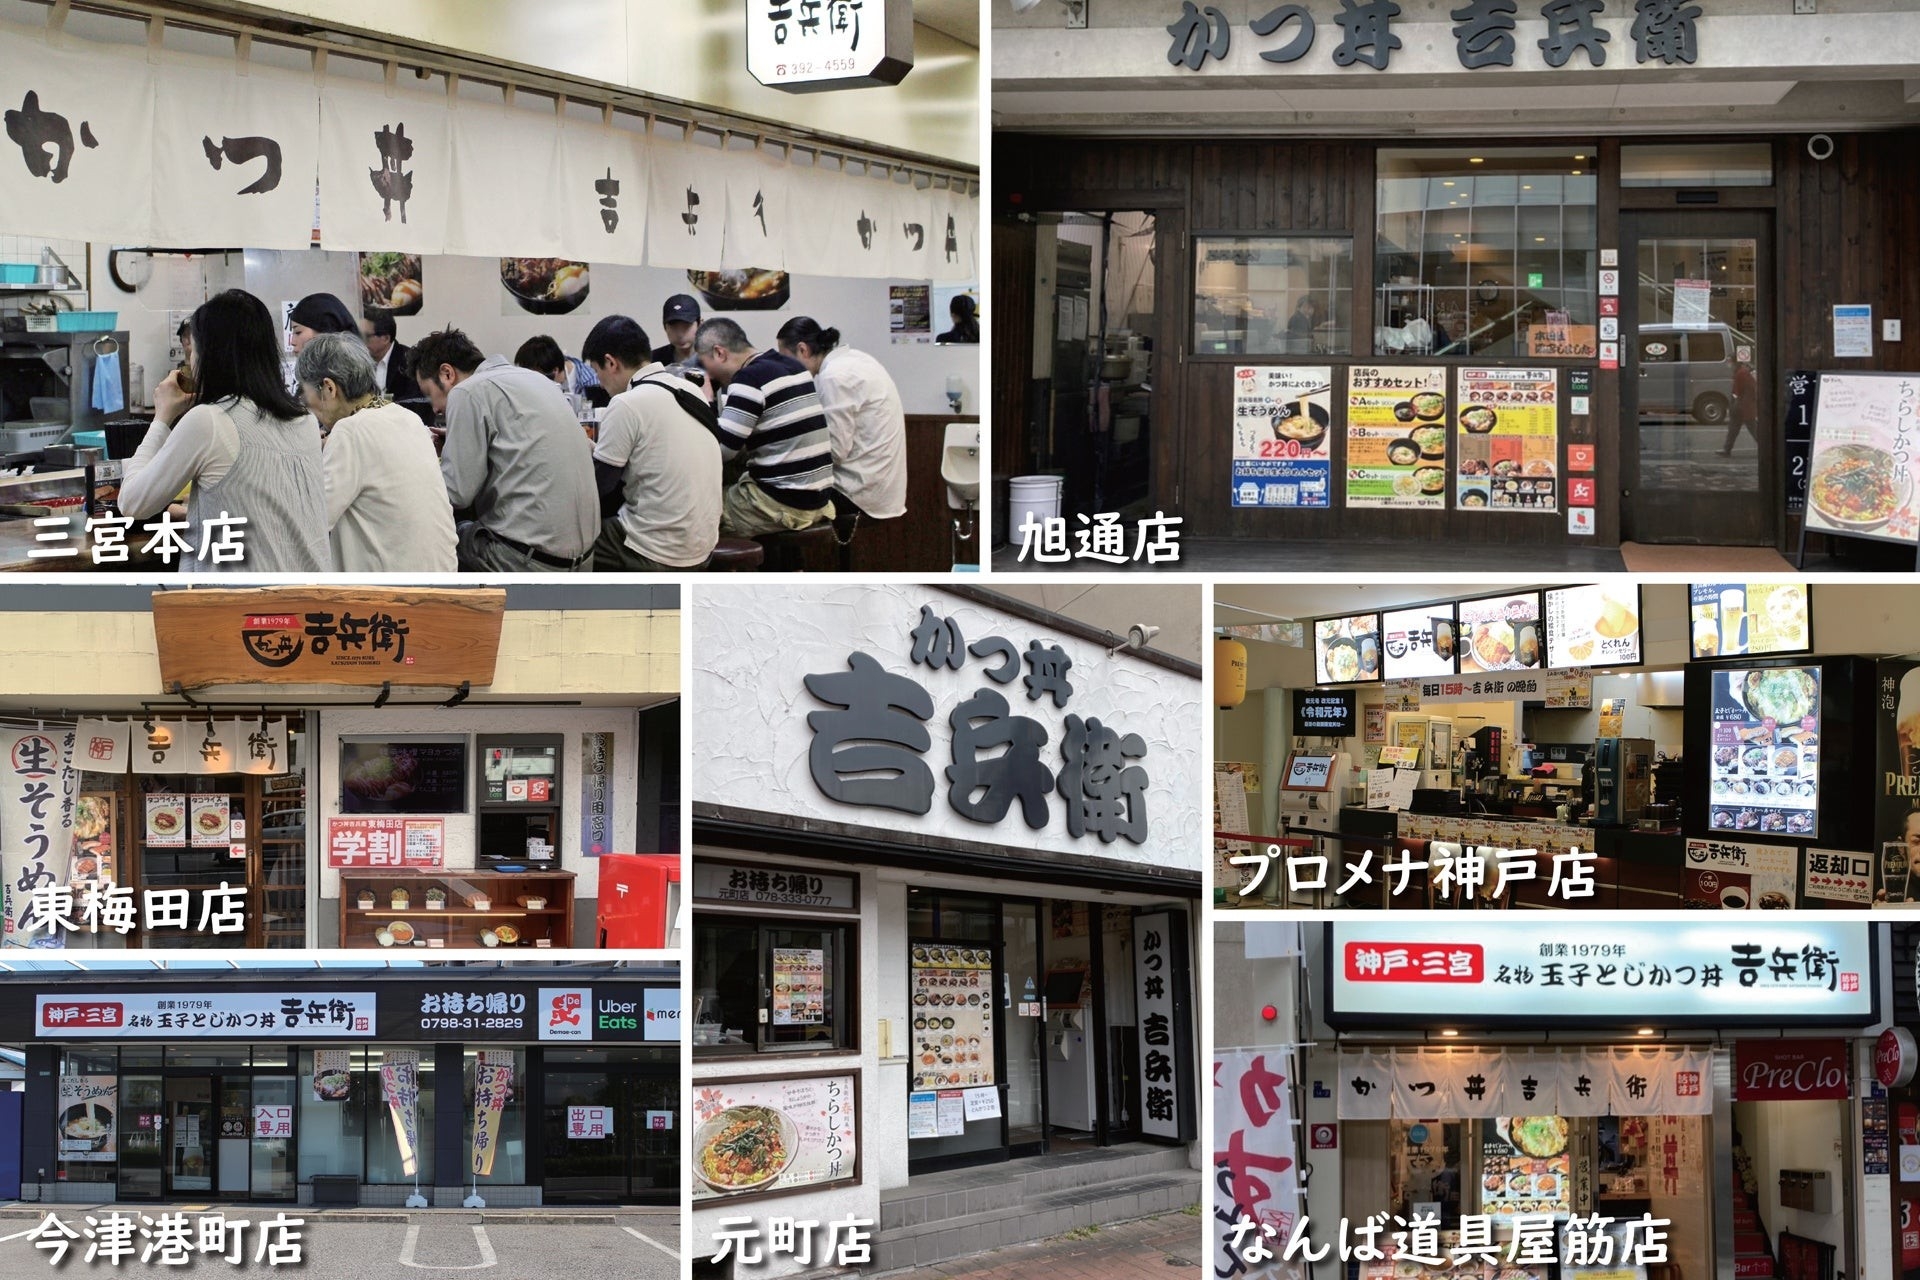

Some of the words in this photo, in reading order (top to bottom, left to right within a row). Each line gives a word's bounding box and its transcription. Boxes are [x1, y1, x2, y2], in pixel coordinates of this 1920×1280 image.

[1166, 0, 1401, 71] かつ丼
[1450, 0, 1703, 70] 吉兵衛
[791, 58, 855, 75] 392-4559
[1353, 368, 1379, 377] 店長の
[1237, 405, 1291, 418] 生そうめん
[1892, 380, 1914, 483] ちらしかつ丼
[304, 611, 410, 663] 吉兵衛
[1601, 638, 1630, 648] とくれん
[910, 604, 1073, 709] かつ丼
[1619, 653, 1637, 661] 100円
[147, 733, 278, 770] 吉兵衛
[803, 650, 1149, 844] 吉兵衛
[1884, 771, 1920, 797] PRE
[367, 819, 403, 829] 東梅田店
[332, 830, 402, 865] 学割
[1708, 843, 1747, 866] 吉兵衛
[1808, 853, 1870, 878] 返却口
[728, 869, 824, 896] お持ち帰り
[718, 887, 750, 900] 元町店
[755, 890, 832, 906] 078-333-0777
[1539, 942, 1627, 957] 創業1979年
[1142, 929, 1165, 1000] かつ丼
[1354, 949, 1474, 977] 神戸・三宮
[1493, 963, 1535, 983] 名物
[1540, 961, 1724, 987] 玉子とじかつ丼
[1731, 943, 1839, 993] 吉兵衛
[157, 1000, 213, 1009] 創業1979年
[420, 992, 526, 1014] お持ち帰り
[568, 997, 580, 1005] De
[599, 999, 637, 1013] Uber
[47, 1007, 118, 1024] 神戸・三宮
[128, 1015, 154, 1028] 名物
[157, 1012, 277, 1029] 玉子とじかつ丼
[280, 998, 356, 1031] 吉兵衛
[421, 1018, 523, 1029] 0798-31-2829
[600, 1016, 637, 1029] Eats
[1142, 1012, 1174, 1122] 吉兵衛
[1743, 1056, 1848, 1092] PreClo
[490, 1067, 510, 1112] かつ丼
[1350, 1075, 1485, 1101] かつ丼
[1520, 1074, 1647, 1101] 吉兵衛
[258, 1108, 290, 1119] 入口
[473, 1066, 495, 1173] お持ち帰り
[570, 1108, 603, 1122] 出口
[257, 1121, 290, 1135] 専用
[570, 1123, 604, 1137] 専用
[826, 1080, 843, 1177] ちらしかつ丼
